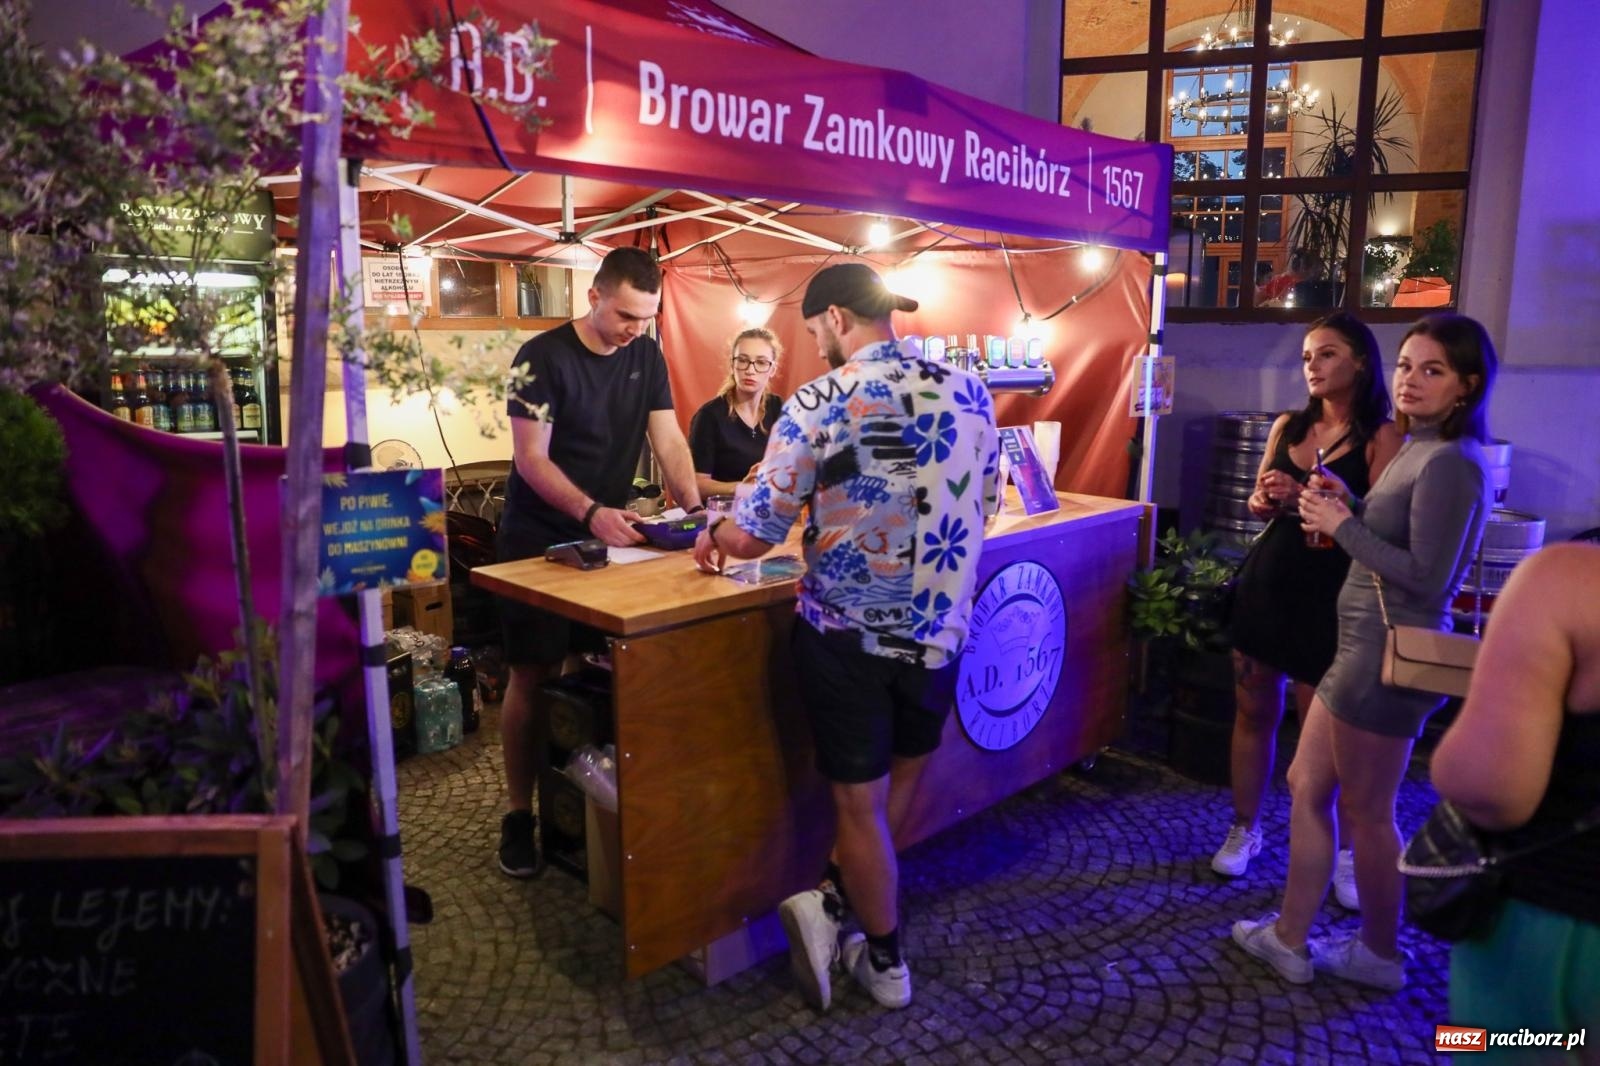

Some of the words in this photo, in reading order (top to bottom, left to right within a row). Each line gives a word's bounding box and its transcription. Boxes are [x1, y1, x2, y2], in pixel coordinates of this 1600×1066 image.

[638, 60, 791, 145] Browar
[803, 94, 955, 183] Zamkowy
[965, 130, 1071, 197] Racibórz
[1102, 165, 1144, 210] 1567
[340, 496, 356, 511] PO
[360, 520, 374, 531] NA
[328, 543, 342, 557] DO
[963, 576, 1007, 655] BROWAR
[961, 664, 1004, 703] A.D.
[1016, 632, 1063, 682] 1567
